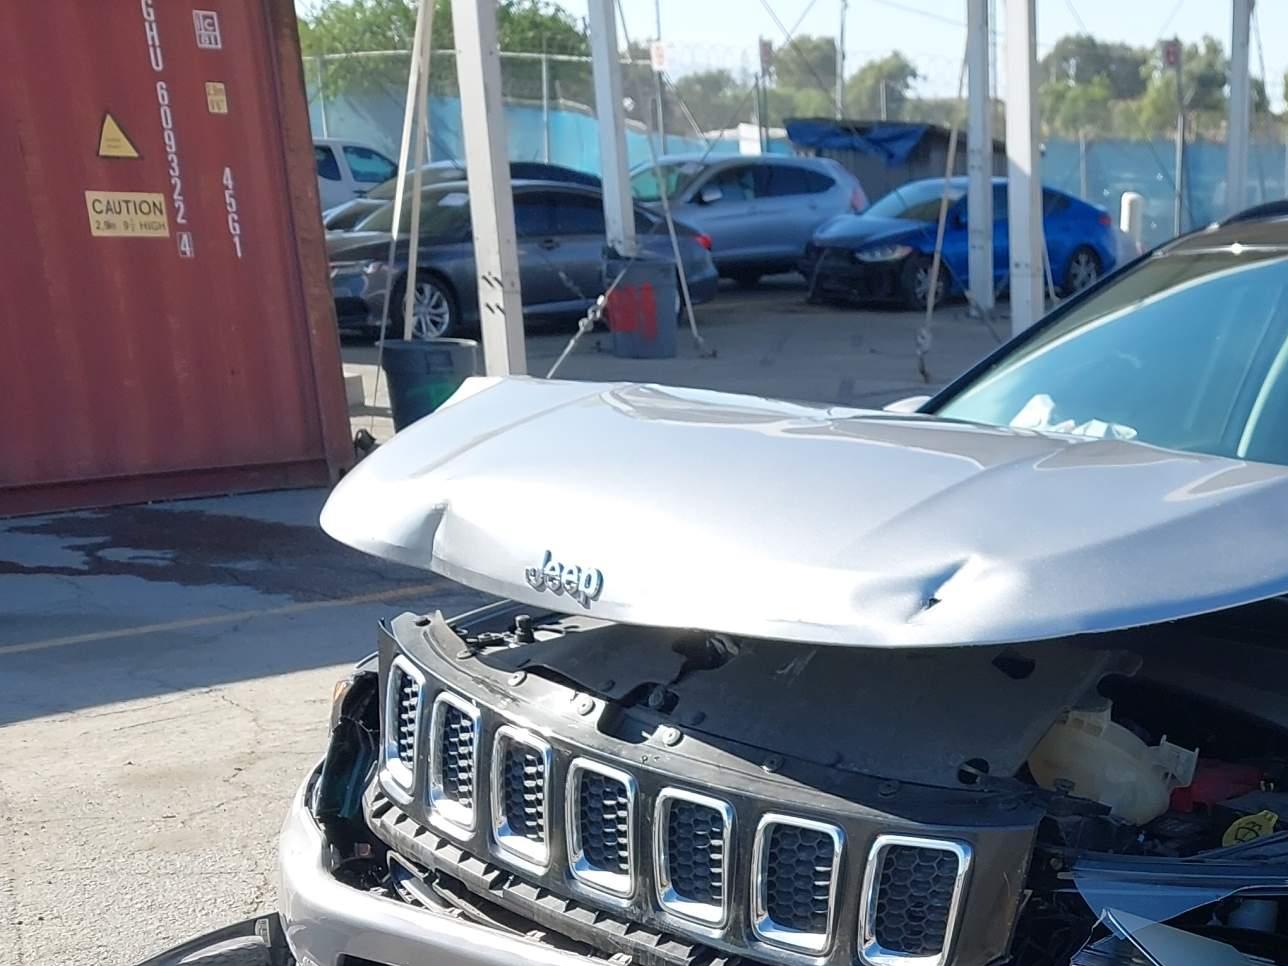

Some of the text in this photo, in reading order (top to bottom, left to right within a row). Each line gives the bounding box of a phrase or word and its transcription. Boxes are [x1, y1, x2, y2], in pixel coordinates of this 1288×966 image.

[156, 81, 187, 224] 609322
[92, 198, 164, 216] CAUTION
[222, 167, 242, 258] 45G1
[525, 550, 604, 609] Jeep
